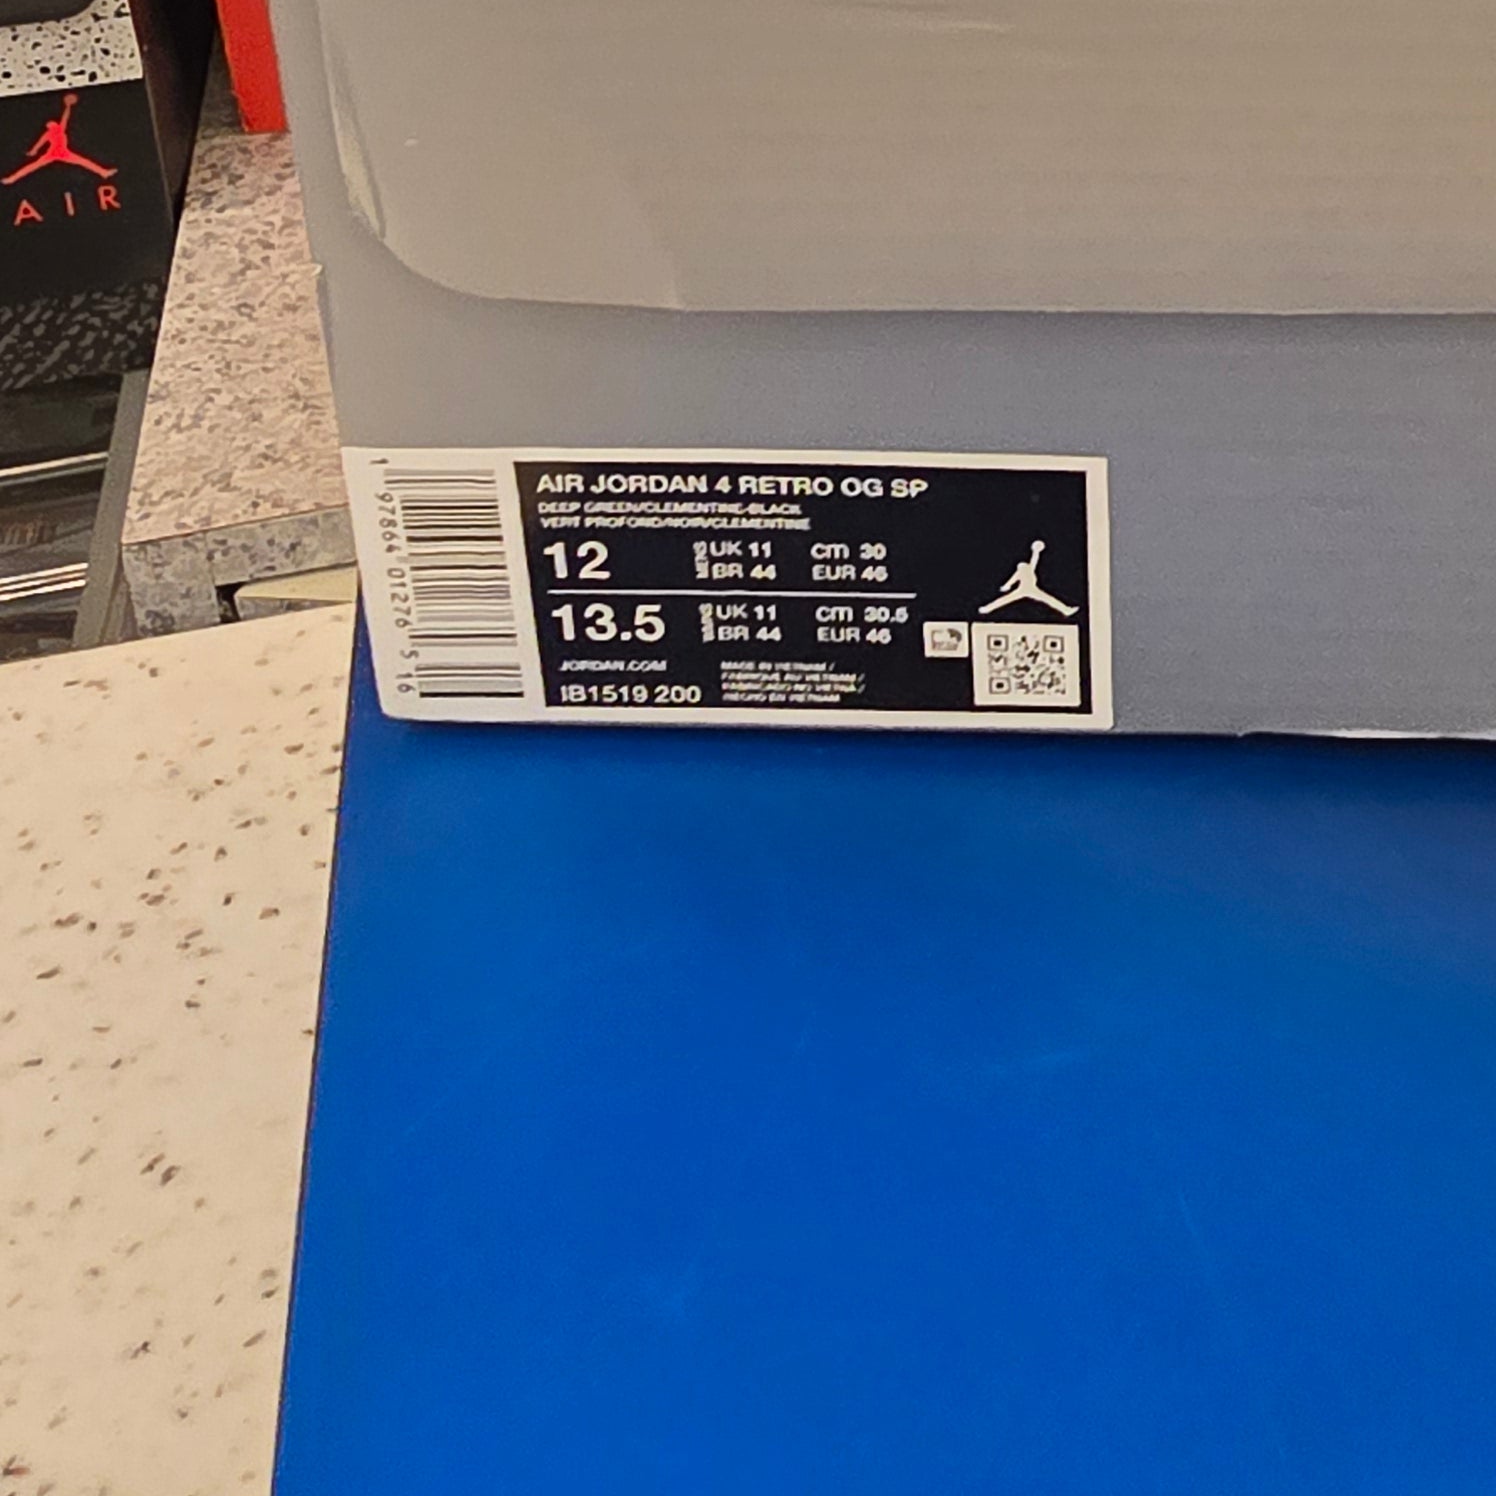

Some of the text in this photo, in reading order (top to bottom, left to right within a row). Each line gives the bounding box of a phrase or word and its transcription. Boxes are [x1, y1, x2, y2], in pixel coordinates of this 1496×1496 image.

[13, 184, 122, 226] AIR
[536, 473, 929, 499] AIR JORDAN 4 RETRO OG SP
[537, 501, 582, 514] DEEP
[374, 492, 401, 553] 97864
[710, 540, 772, 559] UK 11
[859, 543, 887, 560] 30
[543, 540, 611, 580] 12
[712, 562, 777, 580] BR 44
[812, 564, 856, 581] EUR
[387, 568, 411, 628] 01276
[716, 603, 776, 621] UK 11
[551, 602, 666, 642] 13.5
[718, 624, 782, 642] BR 44
[817, 626, 860, 643] EUR
[559, 660, 667, 672] JORDAN.COM
[560, 684, 702, 704] IB1519 200
